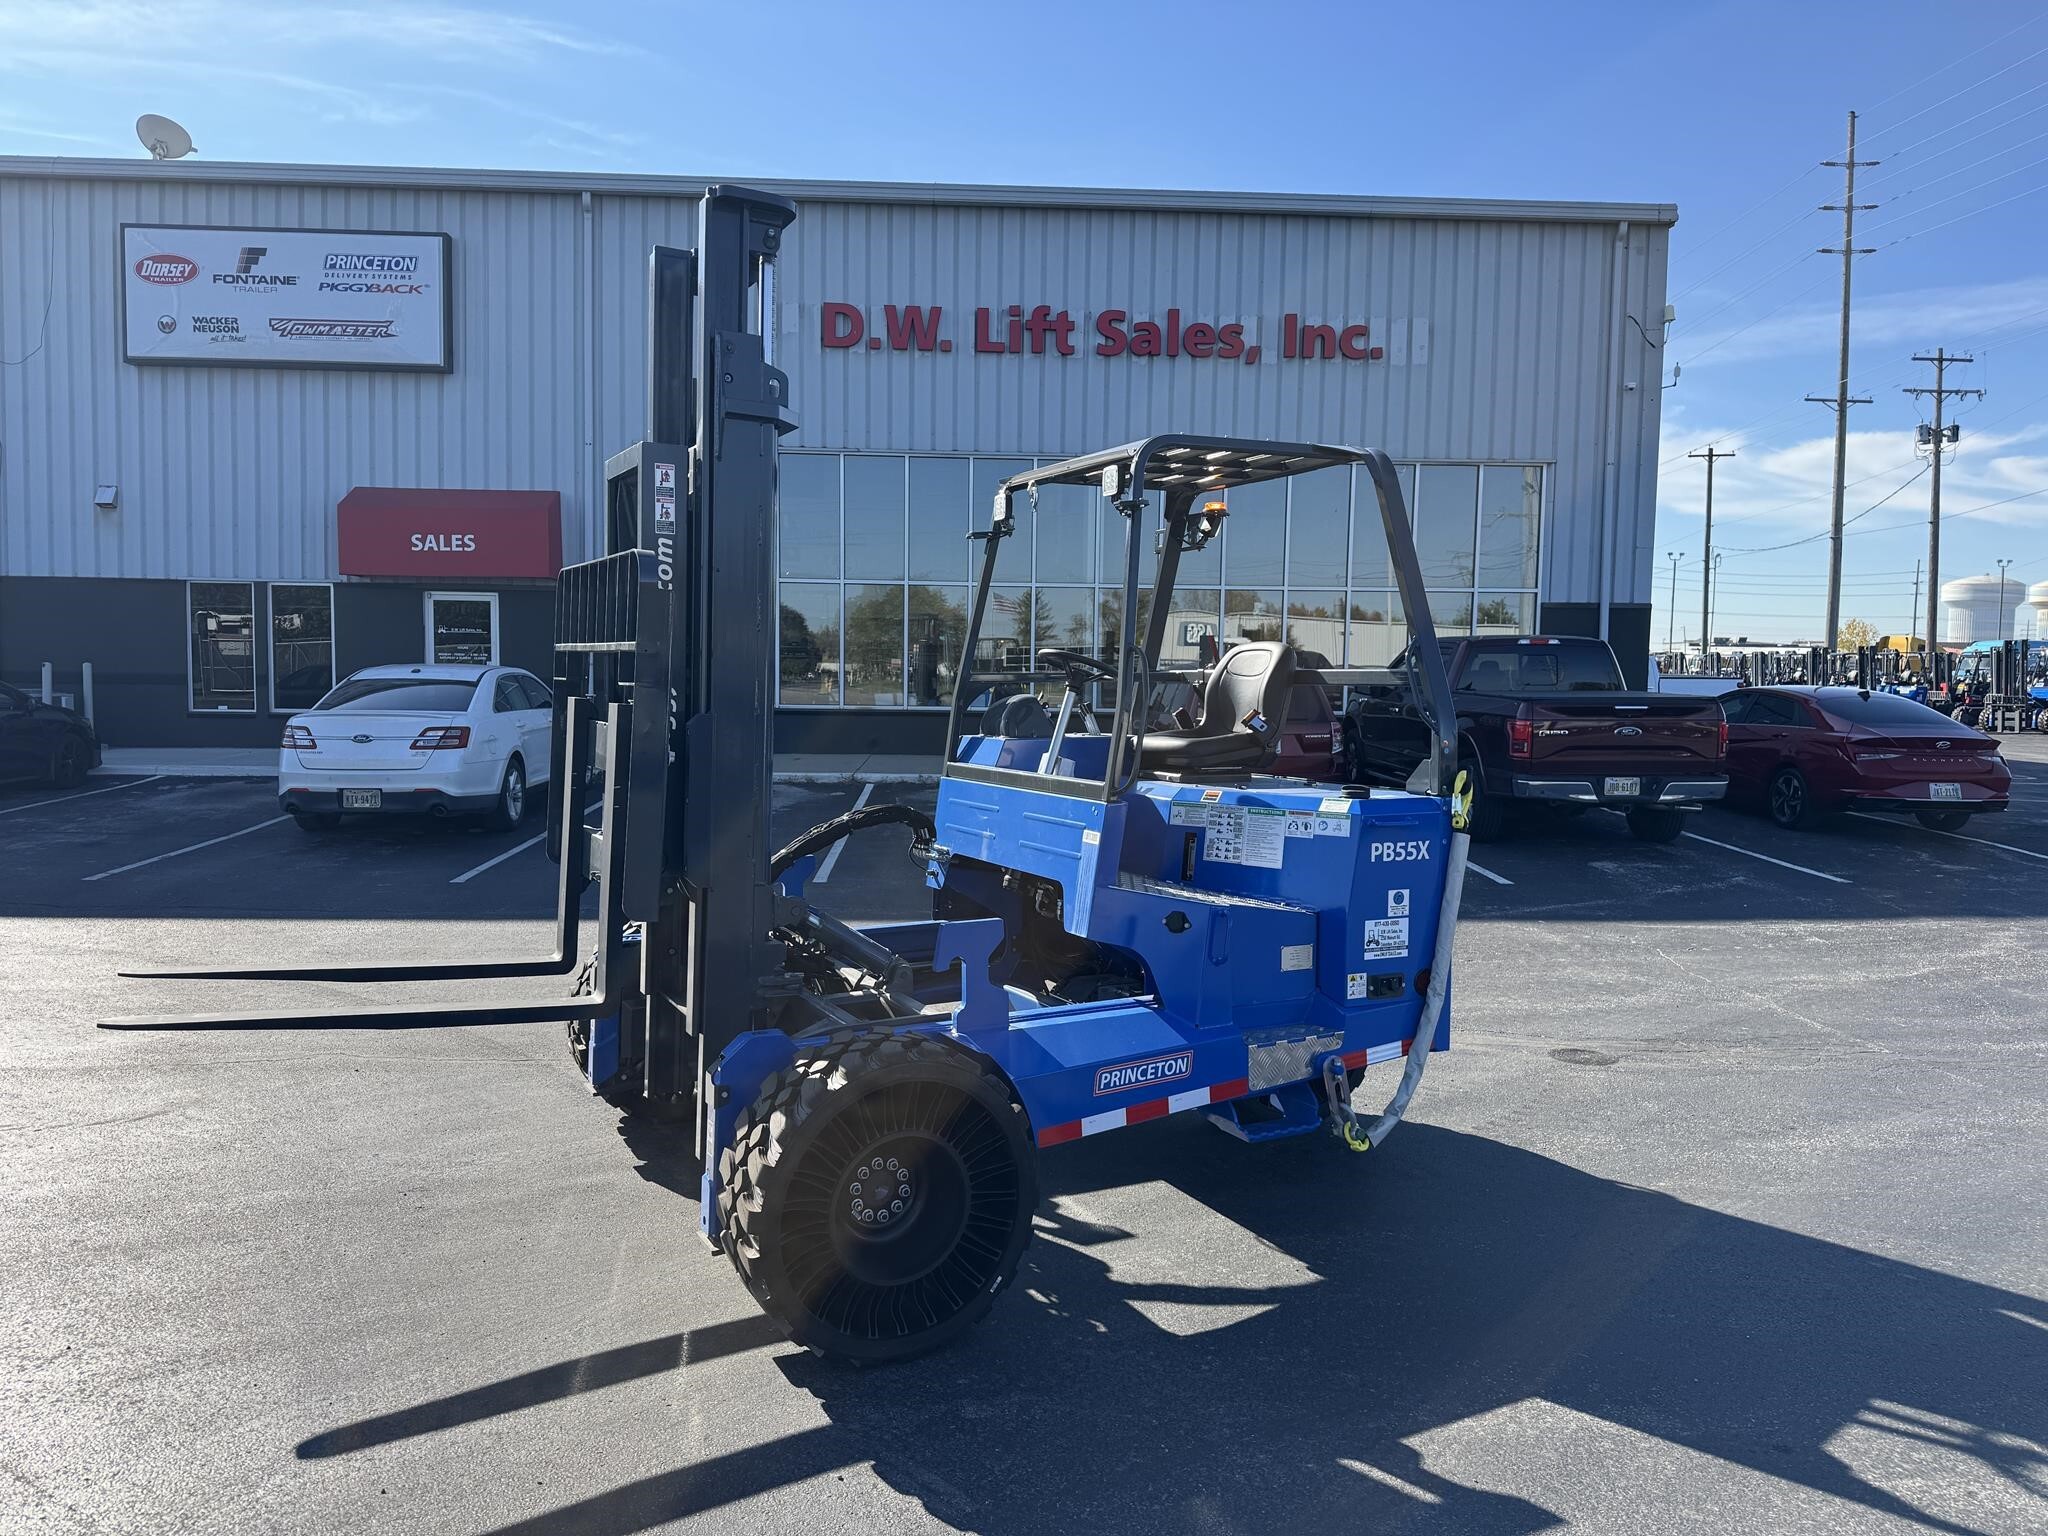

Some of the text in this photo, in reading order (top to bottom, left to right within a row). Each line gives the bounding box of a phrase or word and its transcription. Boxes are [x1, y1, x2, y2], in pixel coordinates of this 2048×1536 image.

[141, 260, 193, 277] DORSEY
[326, 255, 417, 271] PRINCETON
[212, 274, 298, 286] FONTAINE
[324, 272, 412, 281] DELIVERY SYSTEMS
[318, 282, 424, 294] PIGGYBACK
[192, 316, 239, 325] WACKER
[193, 324, 239, 333] NEUSON
[821, 302, 1383, 364] D.W. Lift Sales, Inc.
[411, 534, 476, 551] SALES
[1371, 840, 1430, 862] PB55X
[1100, 1057, 1188, 1089] PRINCETON
